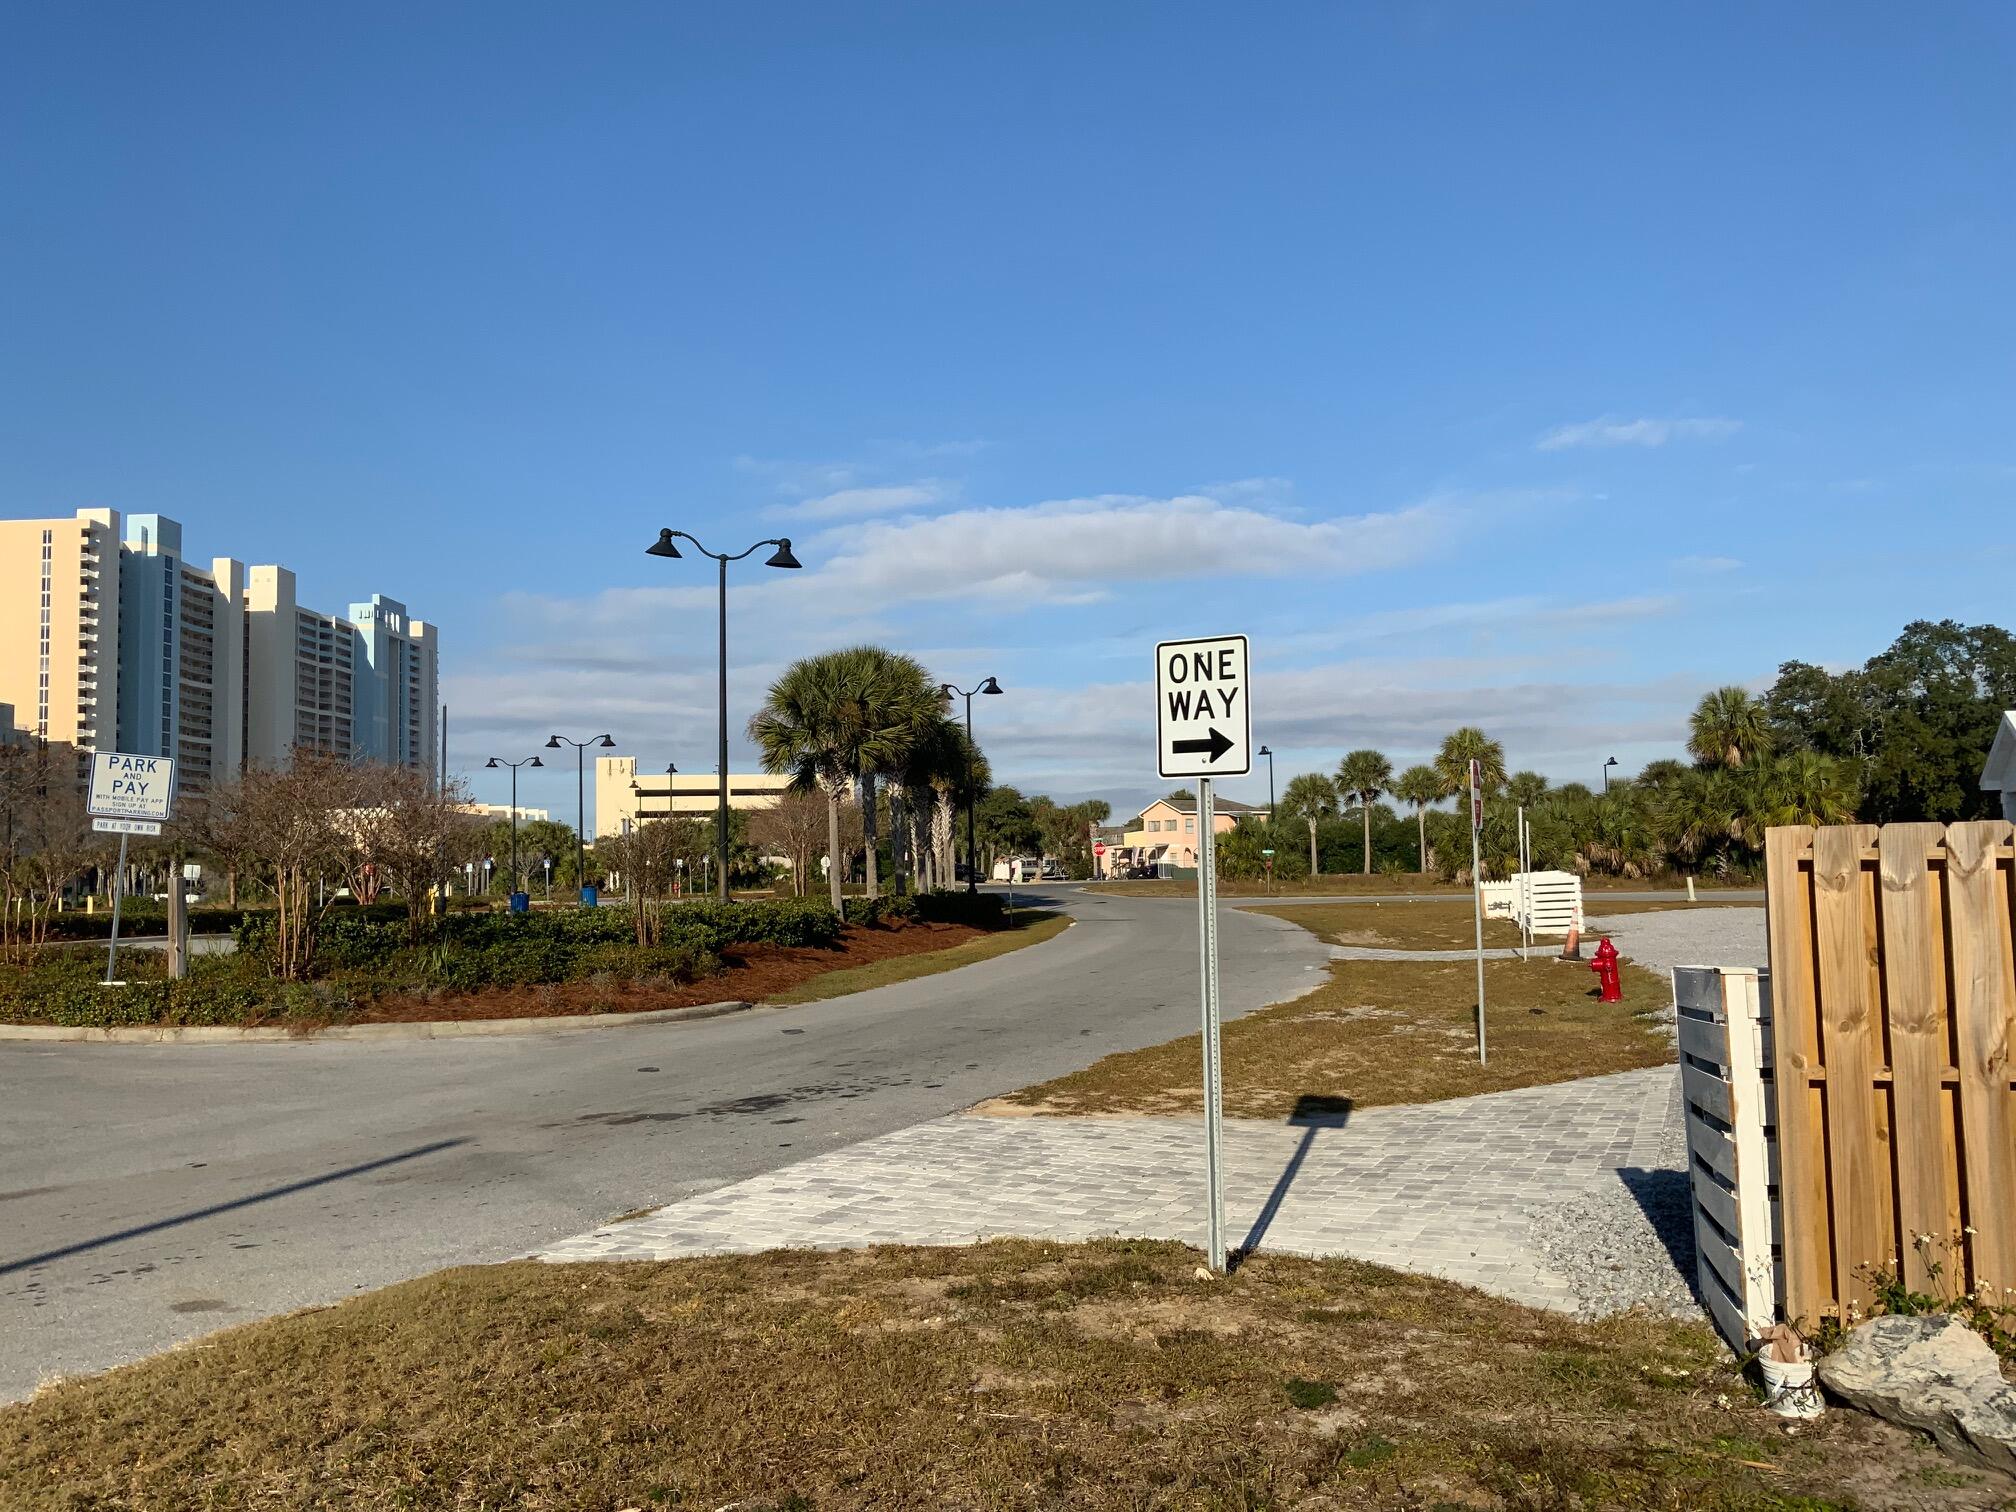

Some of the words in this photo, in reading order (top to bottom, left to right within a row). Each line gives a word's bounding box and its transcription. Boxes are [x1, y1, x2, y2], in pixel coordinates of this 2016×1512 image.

[1169, 649, 1236, 683] ONE
[1168, 687, 1239, 721] WAY
[109, 756, 158, 773] PARK
[112, 780, 149, 795] PAY
[96, 821, 108, 829] PARK
